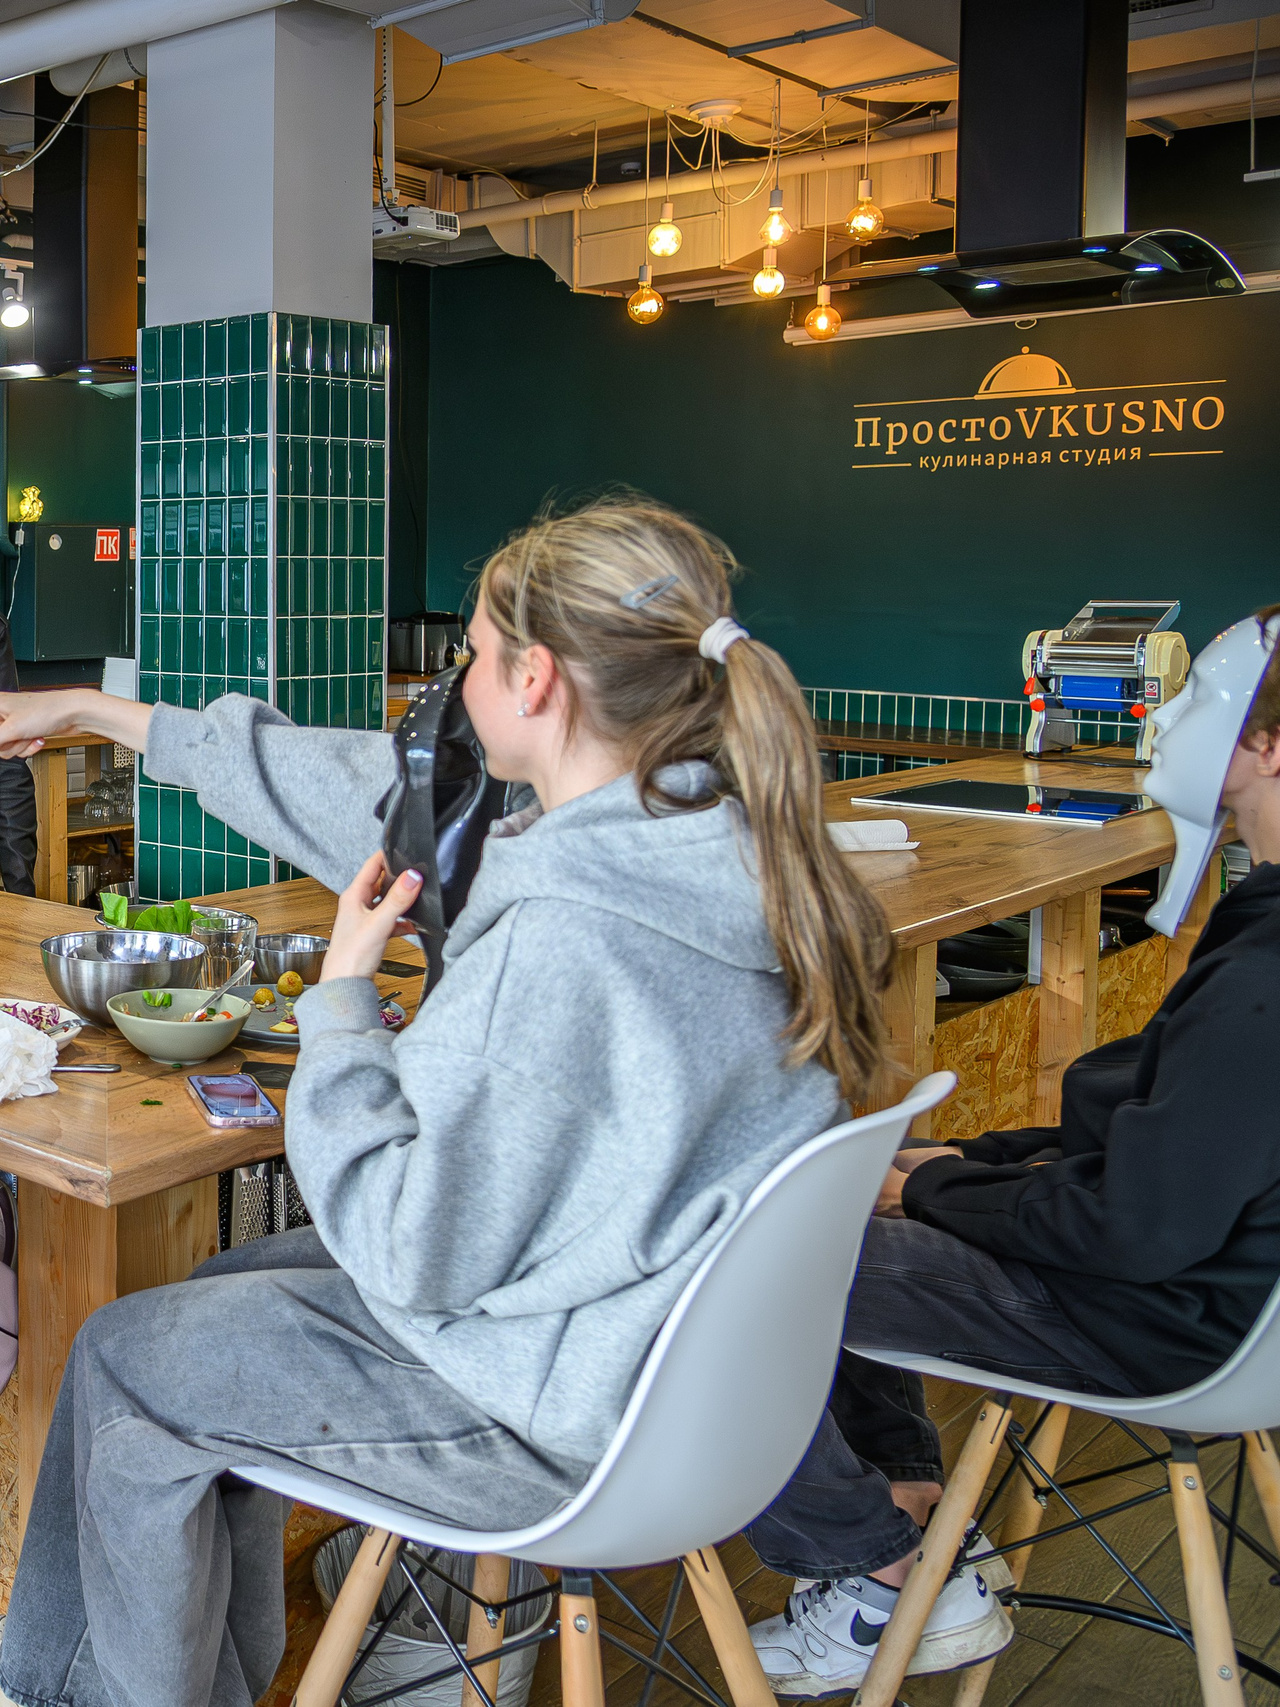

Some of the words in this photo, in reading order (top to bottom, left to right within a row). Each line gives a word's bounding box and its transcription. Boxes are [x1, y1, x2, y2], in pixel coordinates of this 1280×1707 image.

[853, 396, 1226, 455] ПростоVKUSNO
[919, 451, 1052, 472] кулинарная
[1059, 447, 1142, 467] студия
[96, 535, 118, 555] ПК
